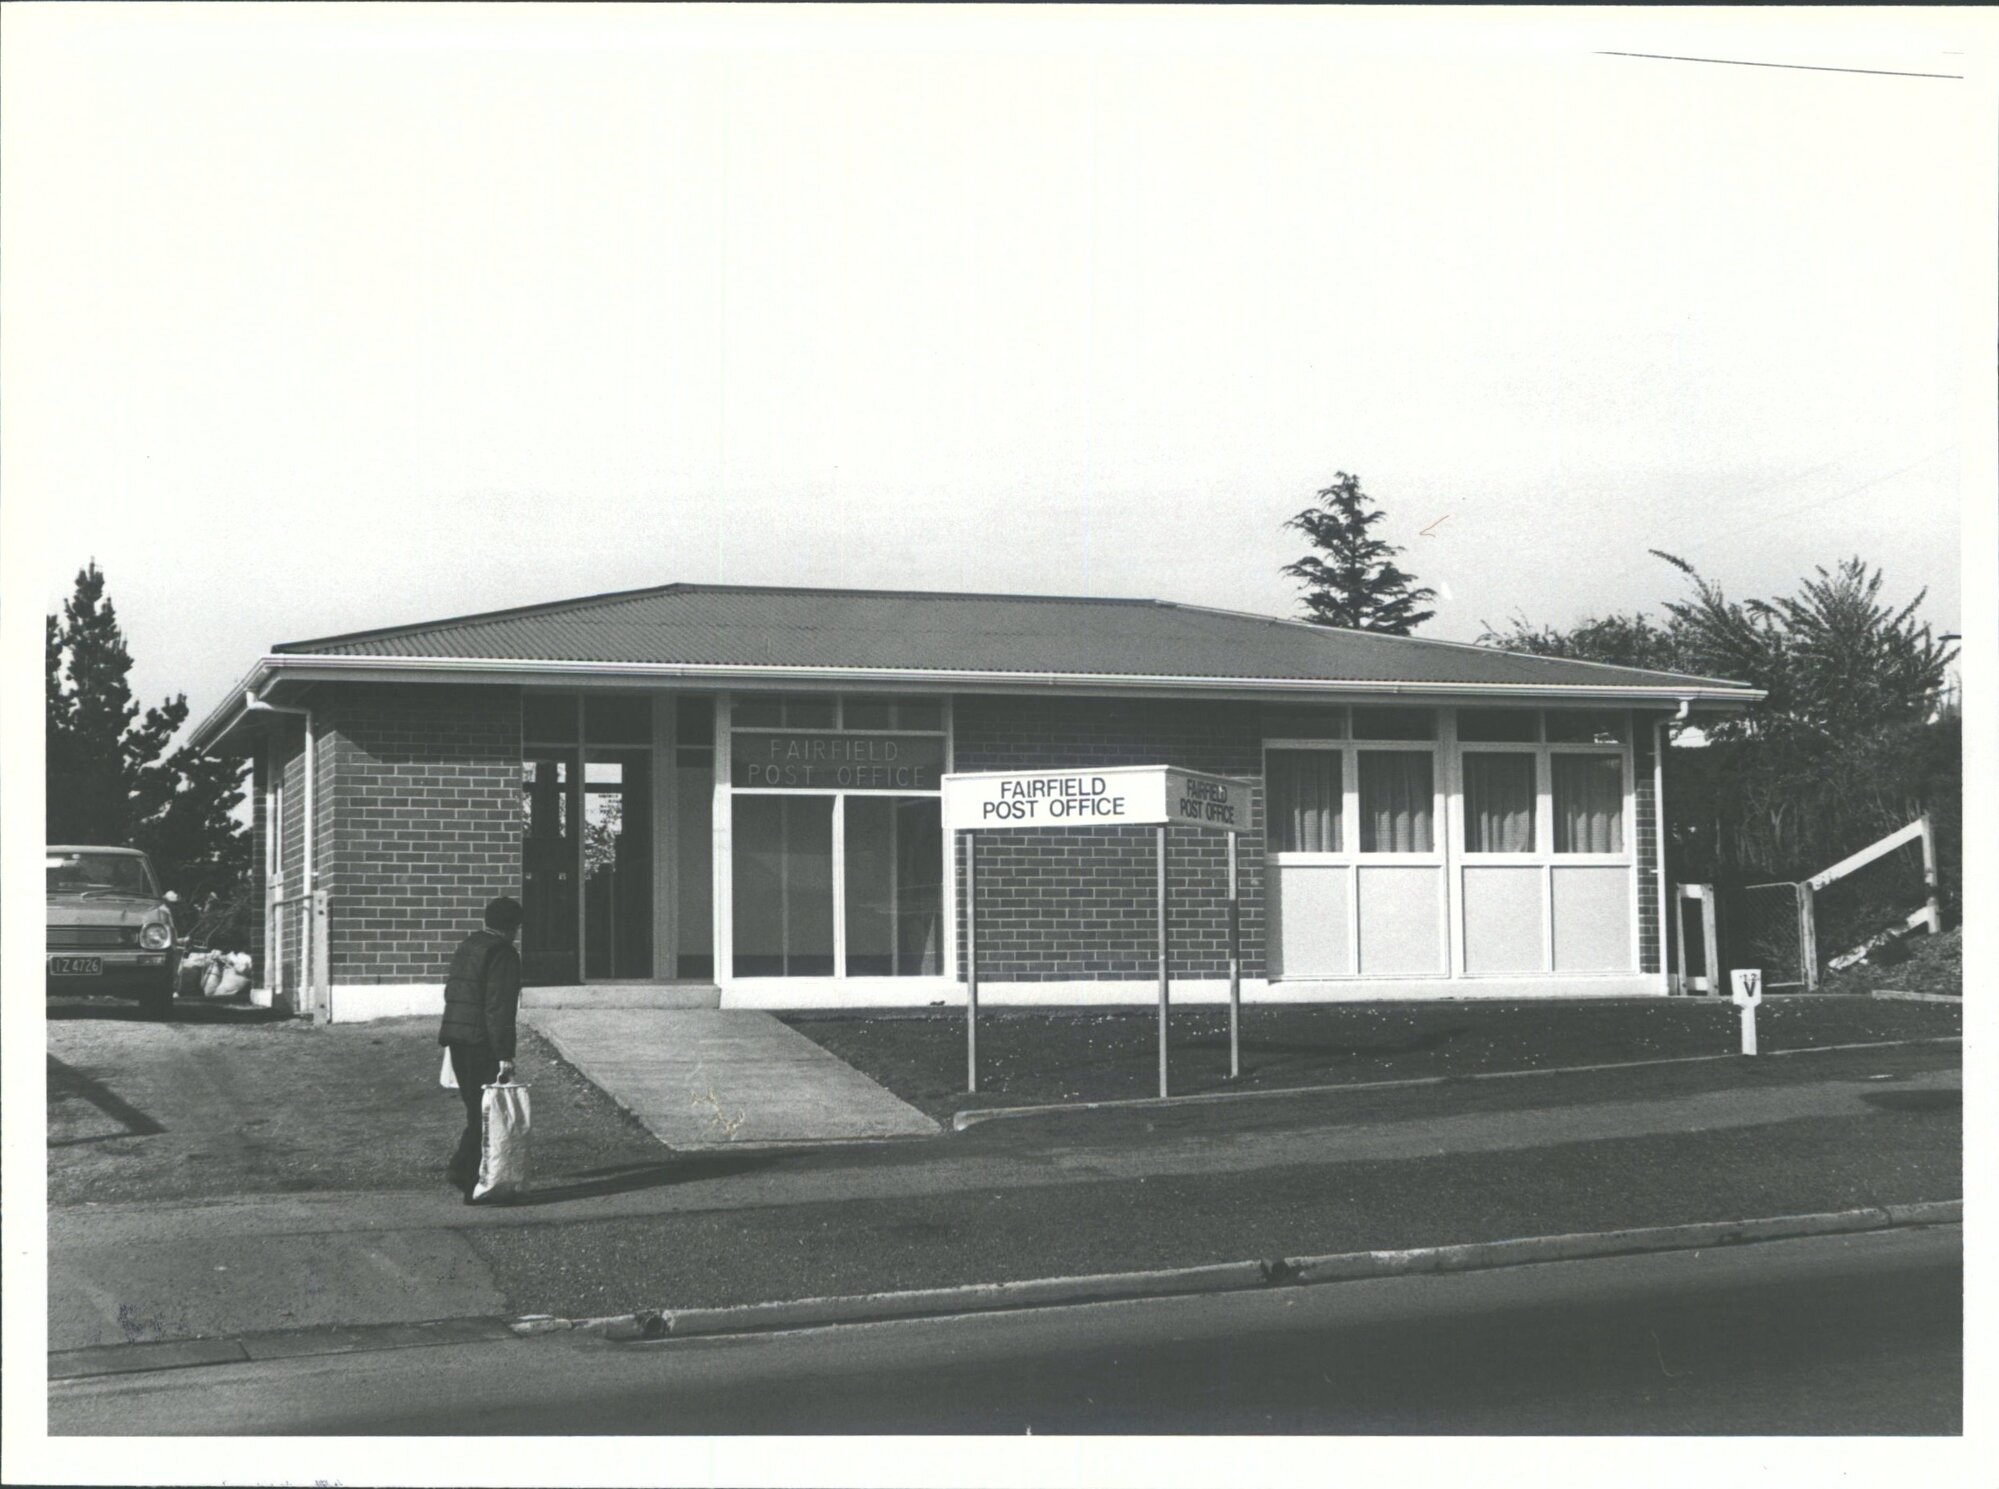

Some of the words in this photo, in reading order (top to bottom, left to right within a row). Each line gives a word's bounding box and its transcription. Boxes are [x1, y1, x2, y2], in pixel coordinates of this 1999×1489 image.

[770, 739, 899, 761] FAIRFIELD
[748, 763, 814, 785] POST
[836, 765, 925, 787] OFFICE
[1000, 777, 1107, 799] FAIRFIELD
[1186, 778, 1228, 804] FAIRFIELD
[983, 800, 1039, 820] POST
[1049, 797, 1125, 818] OFFICE
[1180, 798, 1203, 819] POST
[1206, 802, 1234, 825] OFFICE
[1743, 981, 1756, 997] V
